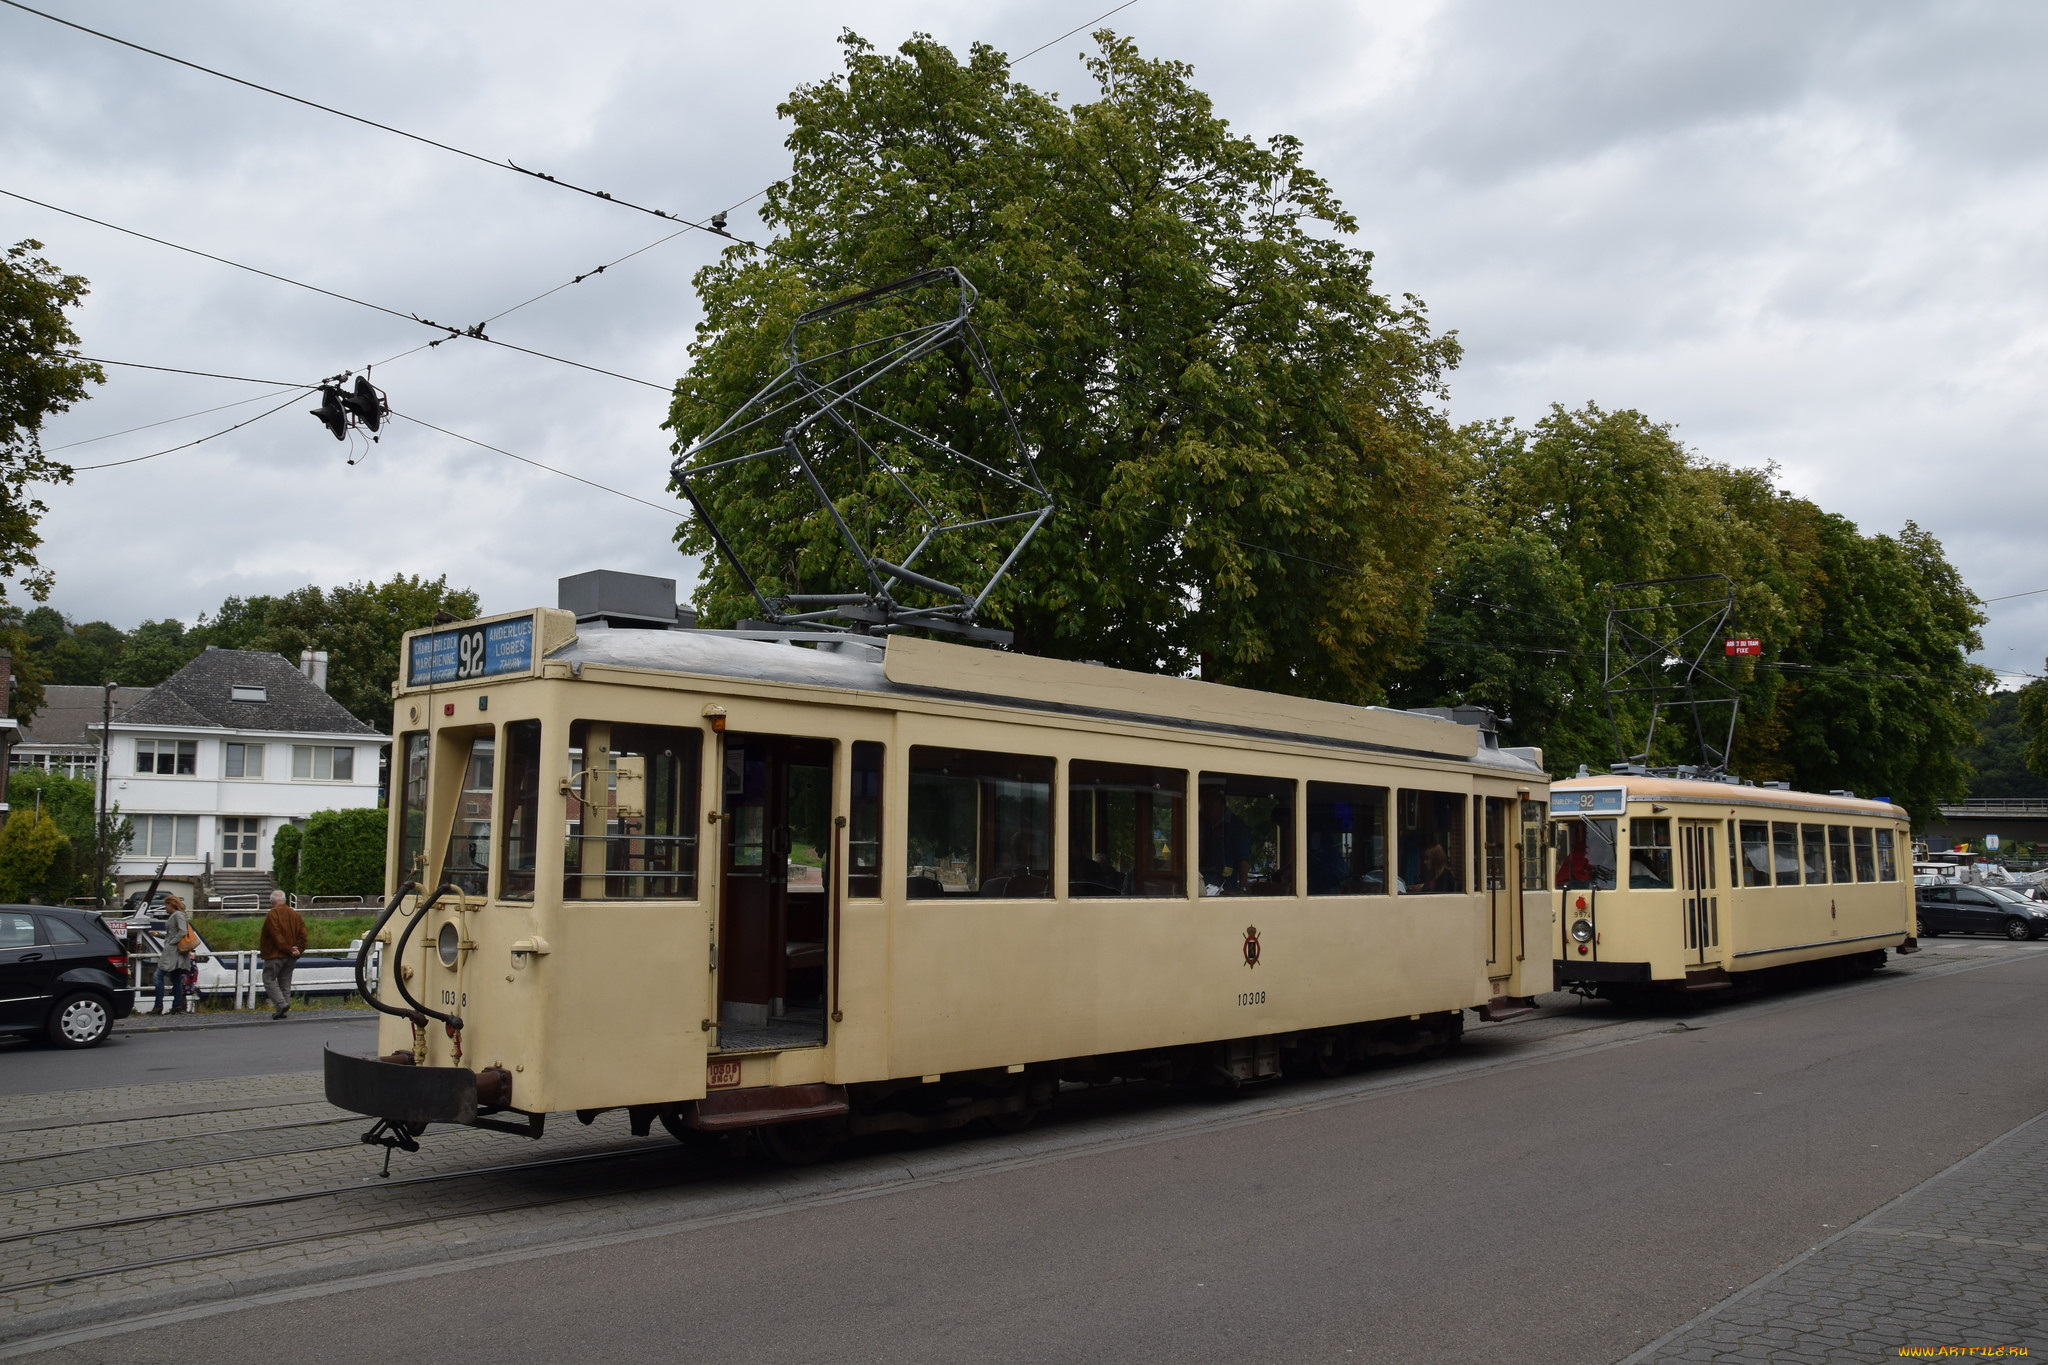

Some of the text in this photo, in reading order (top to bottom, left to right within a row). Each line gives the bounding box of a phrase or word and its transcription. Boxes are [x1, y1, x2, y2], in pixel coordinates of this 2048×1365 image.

[489, 621, 533, 641] ANDERLUES
[459, 631, 484, 678] 92
[495, 639, 525, 657] LOBBES
[1580, 794, 1594, 807] 92
[442, 990, 467, 1008] 1038
[1238, 991, 1266, 1006] 10308
